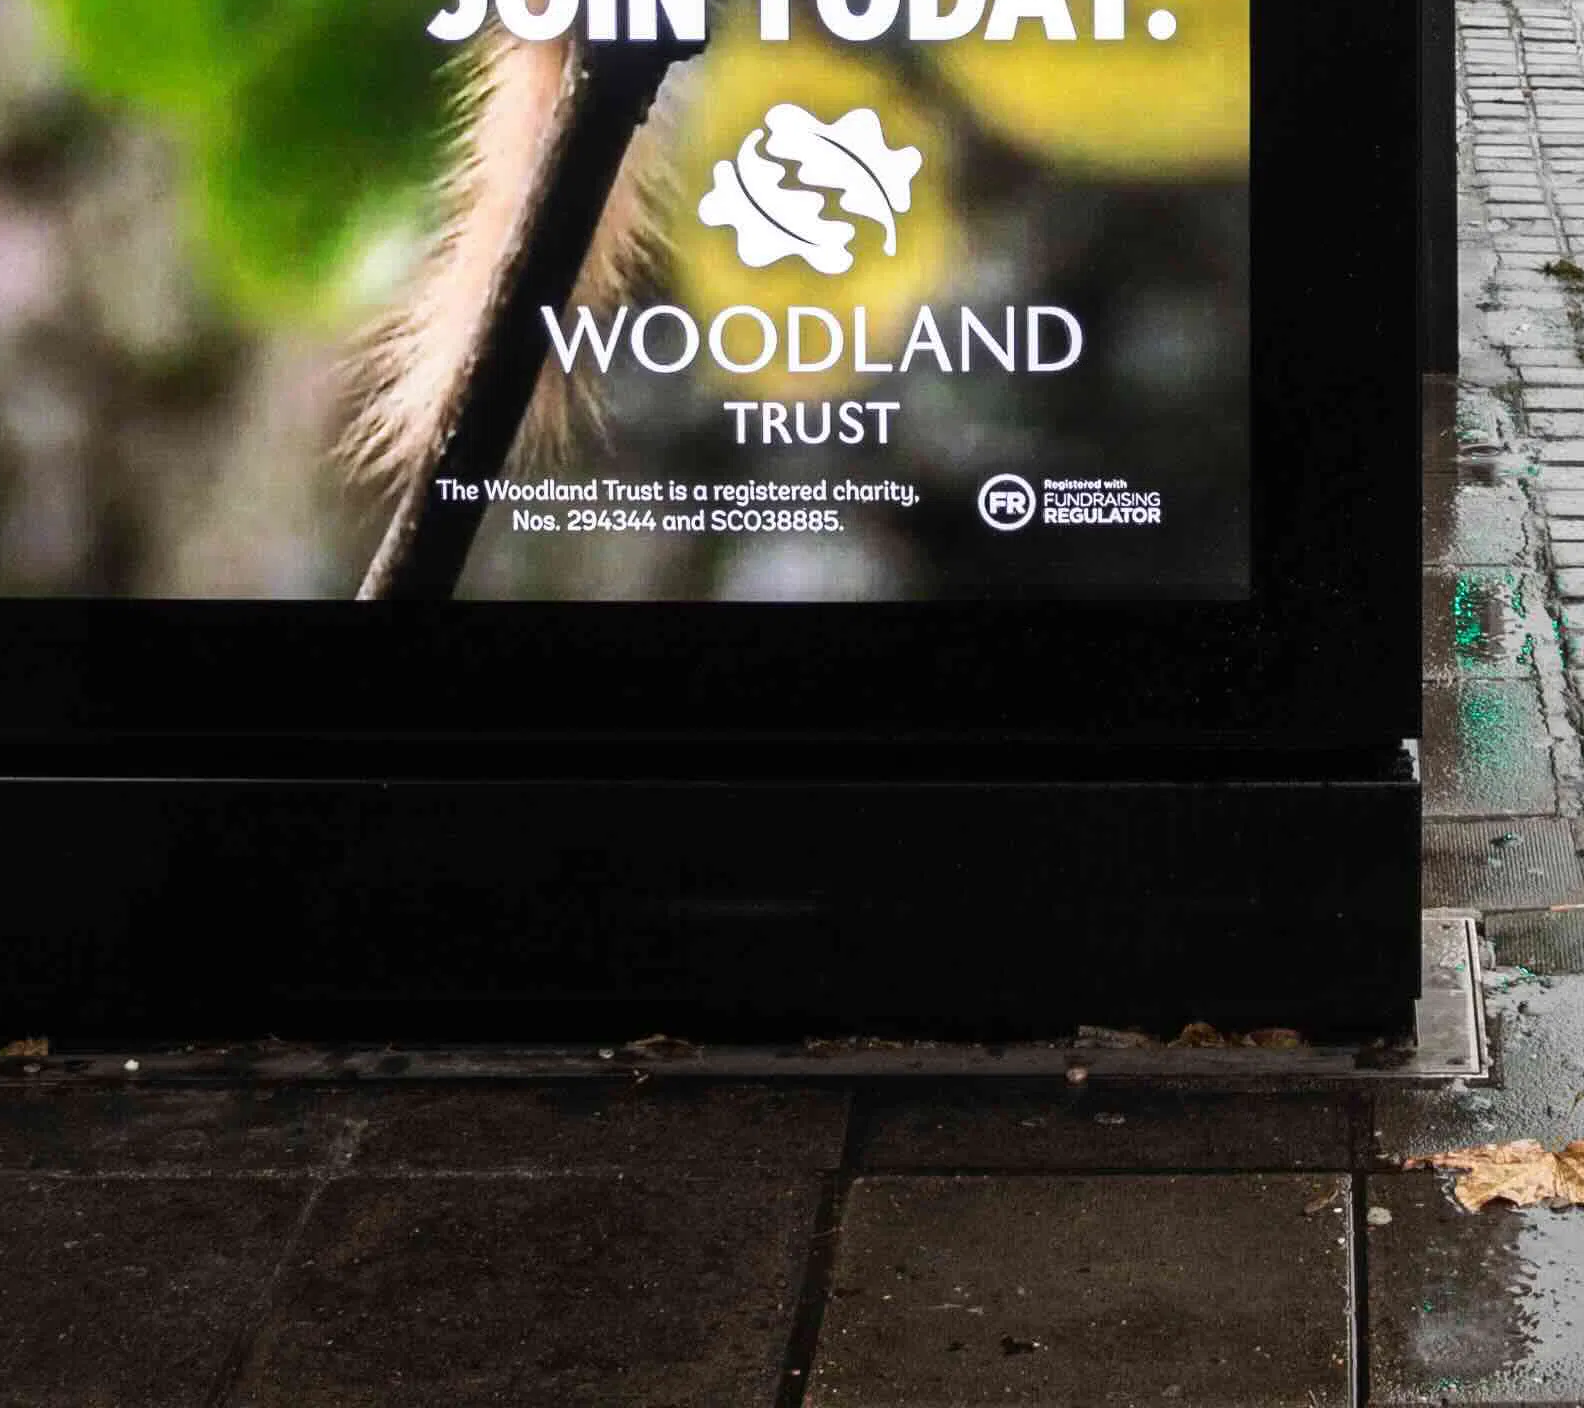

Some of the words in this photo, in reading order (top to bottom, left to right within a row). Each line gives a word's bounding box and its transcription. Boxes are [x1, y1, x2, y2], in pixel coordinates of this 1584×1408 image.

[540, 304, 1083, 374] WOODLAND
[723, 400, 902, 446] TRUST
[435, 478, 479, 502] The
[484, 478, 598, 503] Woodland
[602, 478, 664, 503] Trust
[669, 478, 688, 503] is
[693, 484, 708, 503] a
[713, 479, 827, 508] registered
[832, 478, 921, 508] charity,
[1044, 479, 1102, 491] Registered
[1104, 479, 1128, 490] with
[989, 491, 1027, 516] FR
[1044, 492, 1162, 507] FUNDRAISING
[512, 509, 562, 534] Nos.
[567, 509, 657, 533] 294344
[662, 509, 705, 533] and
[1044, 506, 1162, 525] REGULATOR
